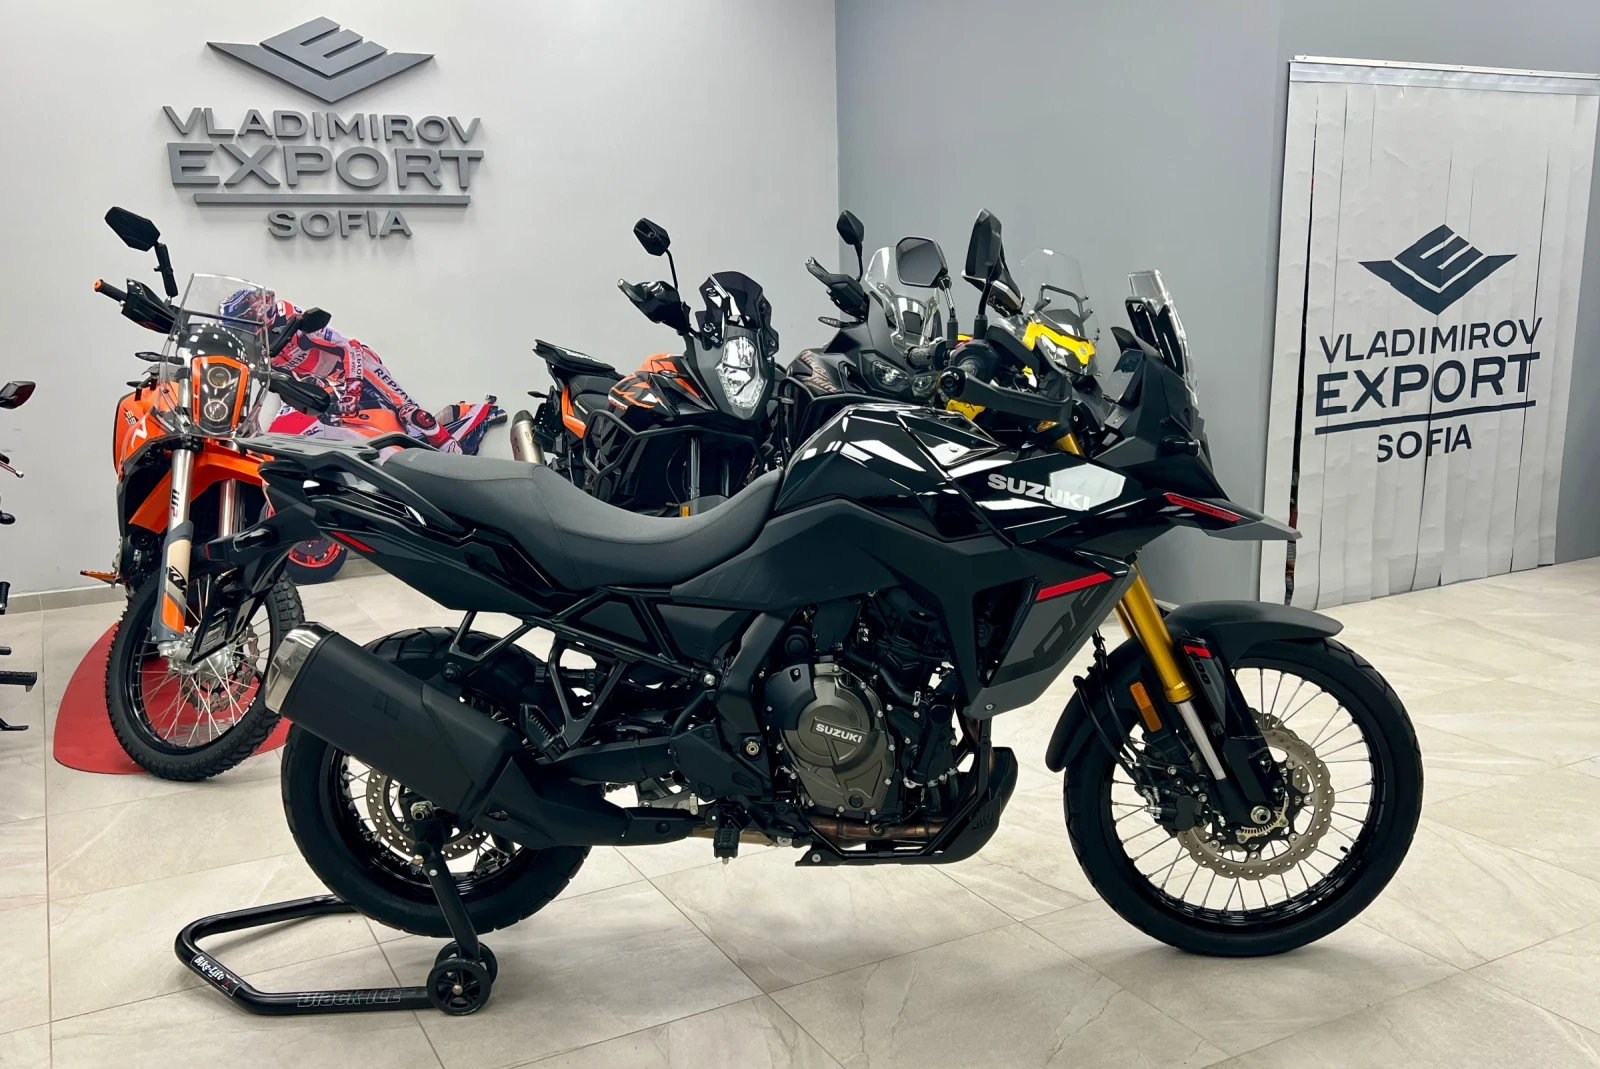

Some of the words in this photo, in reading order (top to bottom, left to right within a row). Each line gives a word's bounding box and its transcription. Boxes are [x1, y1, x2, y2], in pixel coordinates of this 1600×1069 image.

[163, 106, 481, 143] VLADIMIROV
[167, 142, 484, 189] EXPORT
[268, 210, 413, 239] SOFIA
[1319, 317, 1543, 364] VLADIMIROV
[1315, 352, 1540, 417] EXPORT
[1376, 424, 1472, 463] SOFIA
[987, 473, 1091, 512] SUZUKI
[815, 723, 863, 744] SUZUKI
